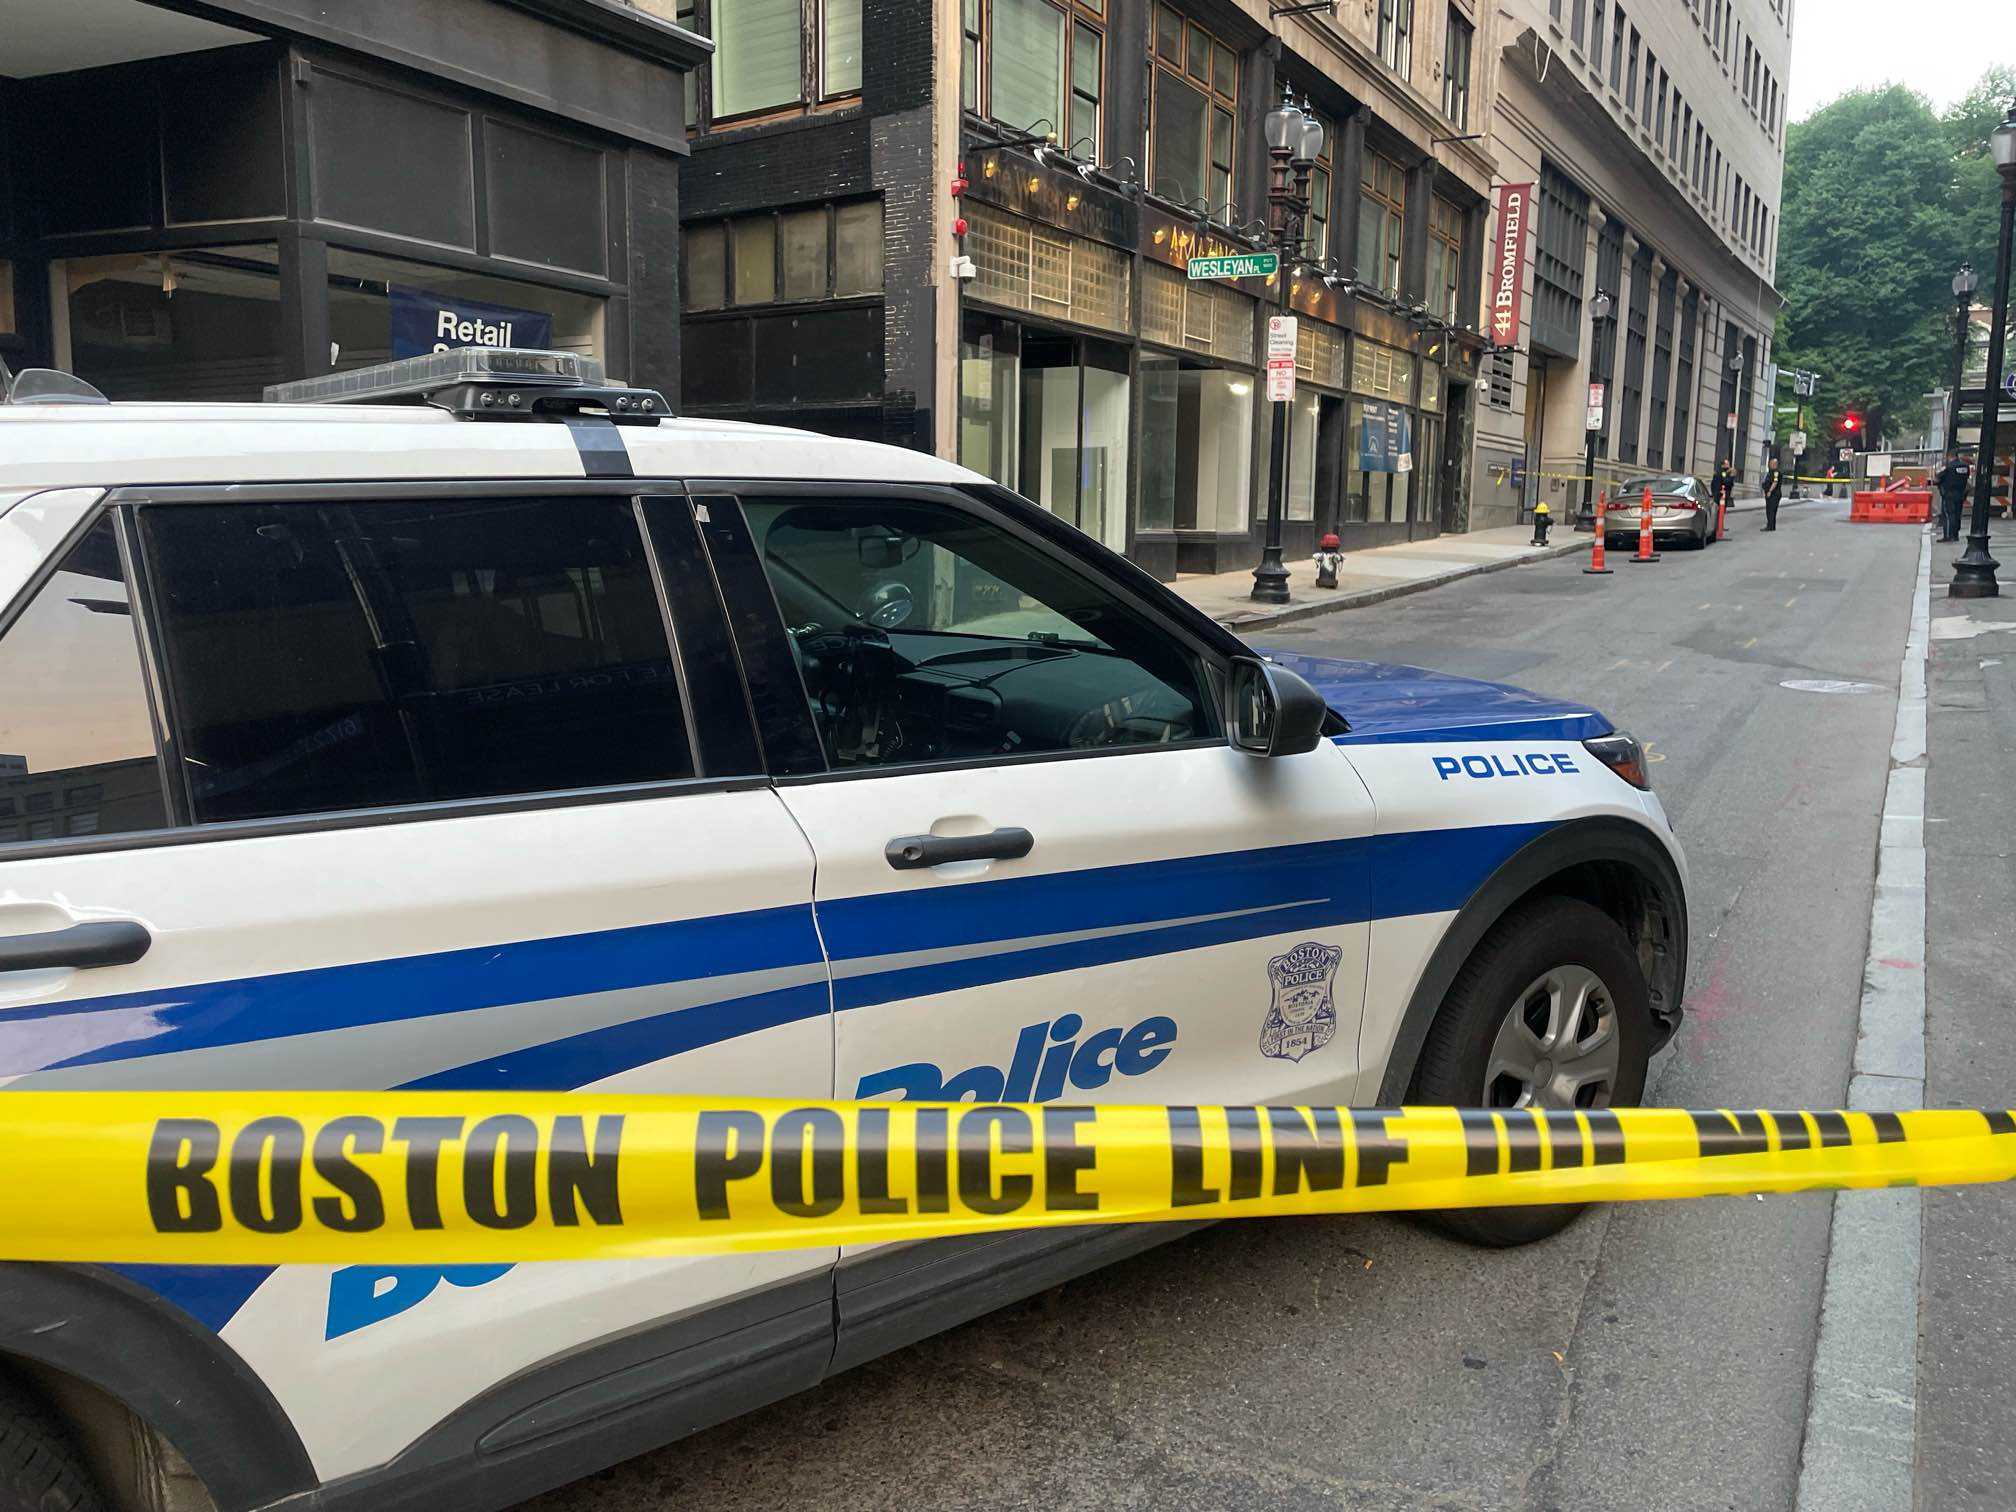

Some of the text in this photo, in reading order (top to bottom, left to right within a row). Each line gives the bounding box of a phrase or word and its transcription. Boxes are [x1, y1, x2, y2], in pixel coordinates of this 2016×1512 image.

[1191, 258, 1254, 277] WESLEYAN
[1494, 192, 1522, 336] 44 BROMFIELD
[437, 310, 512, 348] Retail
[1432, 753, 1580, 780] POLICE
[1283, 947, 1329, 969] BOSTON
[1284, 970, 1323, 986] POLICE
[1286, 1037, 1307, 1048] 1854
[147, 1114, 626, 1234] BOSTON
[694, 1107, 1100, 1220] POLICE
